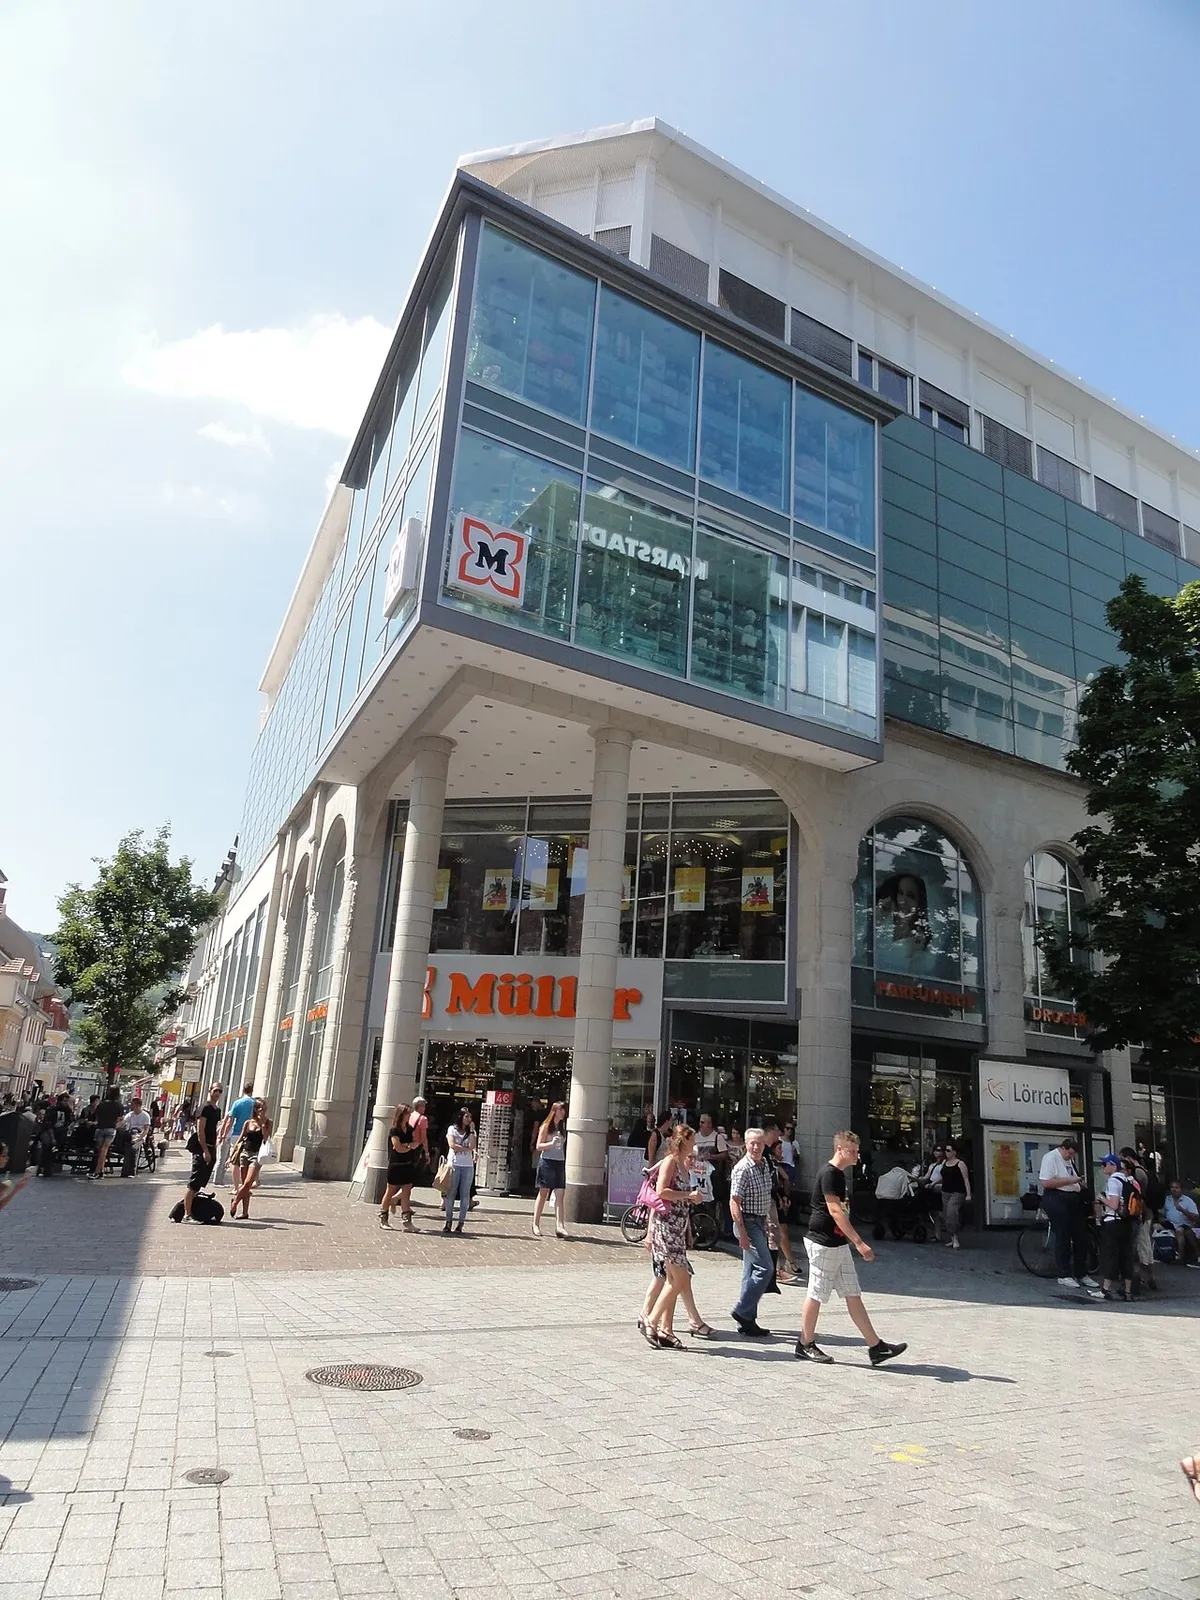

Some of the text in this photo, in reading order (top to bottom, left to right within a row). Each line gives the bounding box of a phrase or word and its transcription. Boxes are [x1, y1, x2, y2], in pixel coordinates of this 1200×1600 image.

[475, 541, 509, 576] M
[445, 972, 642, 1020] Müllr
[1032, 1006, 1090, 1027] DROGER
[1013, 1082, 1069, 1107] Lörrach
